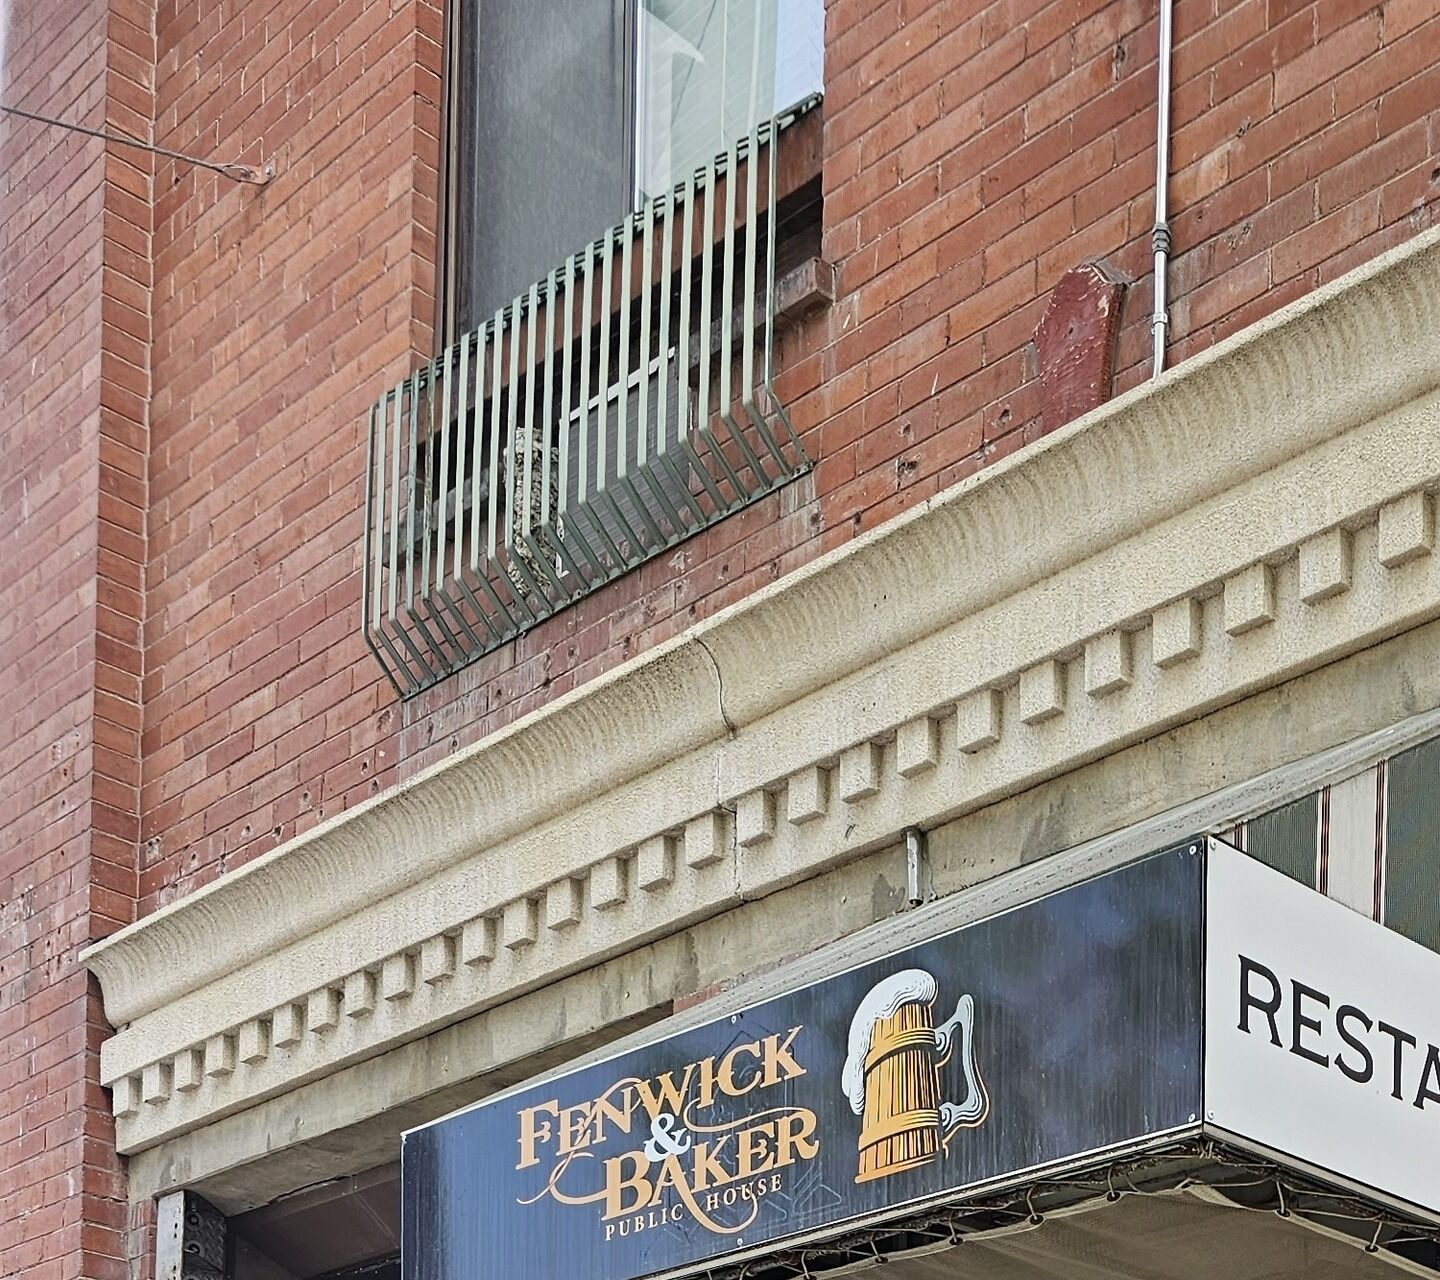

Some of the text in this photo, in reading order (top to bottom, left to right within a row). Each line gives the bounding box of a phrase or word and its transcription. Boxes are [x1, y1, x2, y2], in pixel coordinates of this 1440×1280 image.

[515, 1025, 807, 1171] FENWICK
[643, 1112, 692, 1163] &
[599, 1109, 820, 1222] BAKER
[604, 1173, 782, 1242] PUBLIC HOUSE
